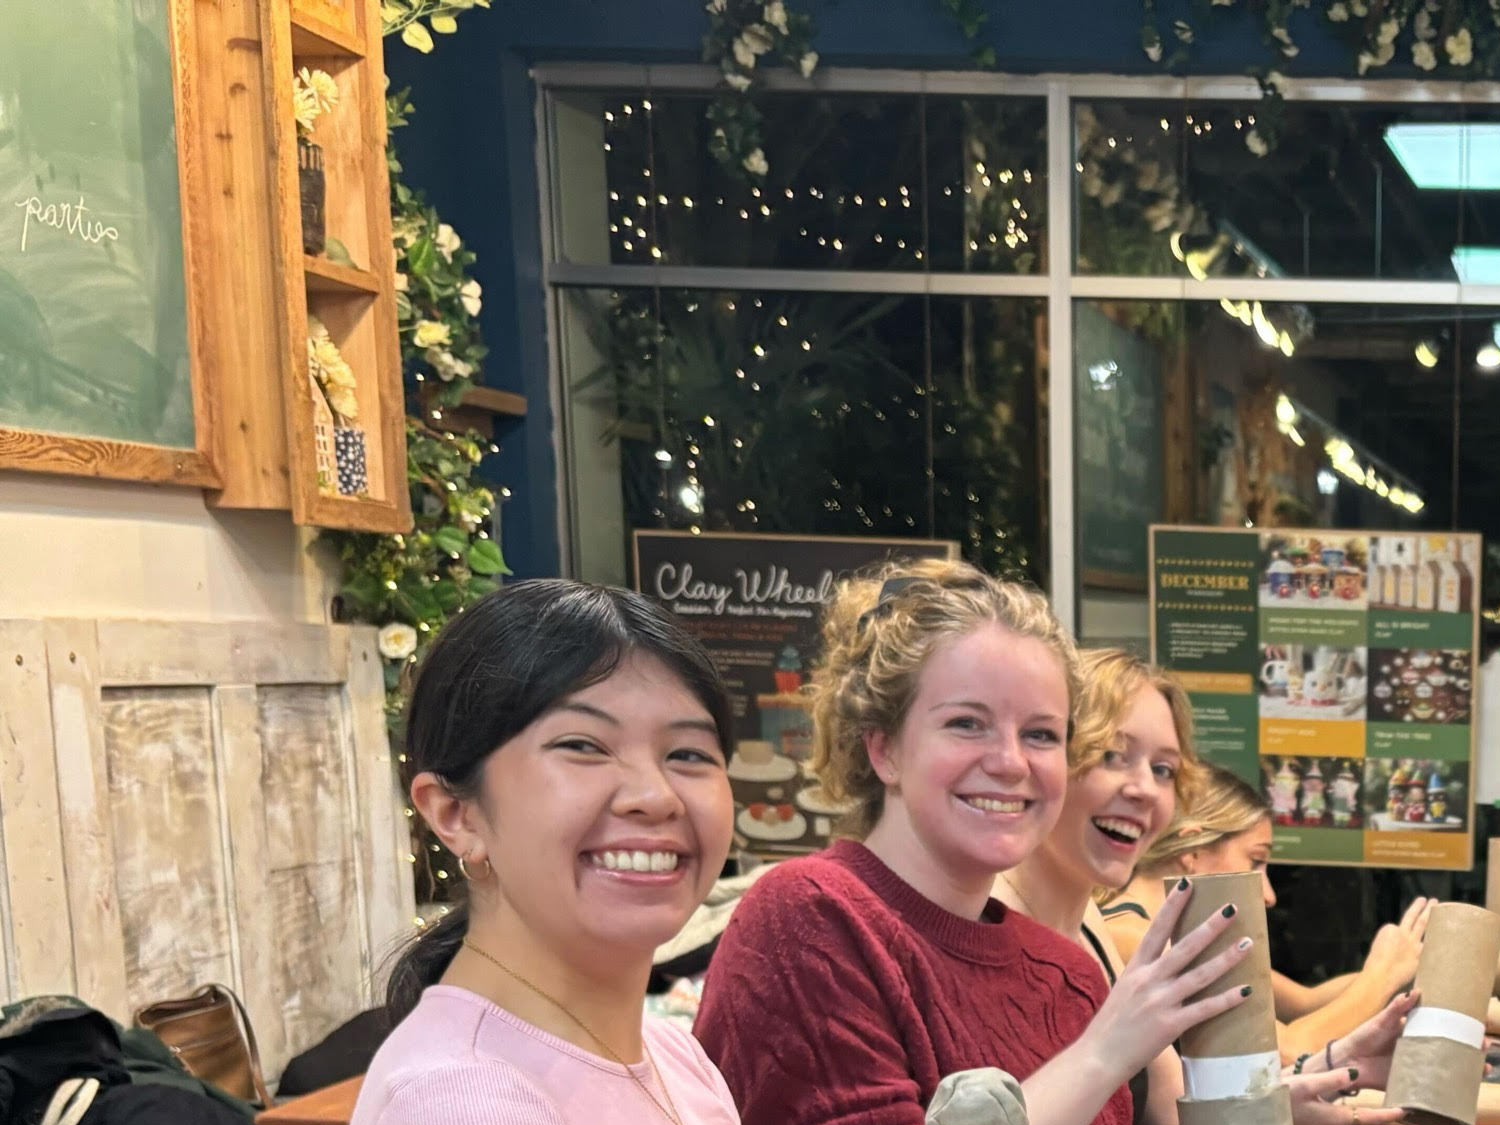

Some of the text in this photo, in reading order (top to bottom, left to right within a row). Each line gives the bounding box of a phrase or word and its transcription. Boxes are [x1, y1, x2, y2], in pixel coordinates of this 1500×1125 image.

[15, 196, 119, 251] parties
[656, 562, 834, 616] Clay Wheel
[1160, 574, 1249, 590] DECEMBER
